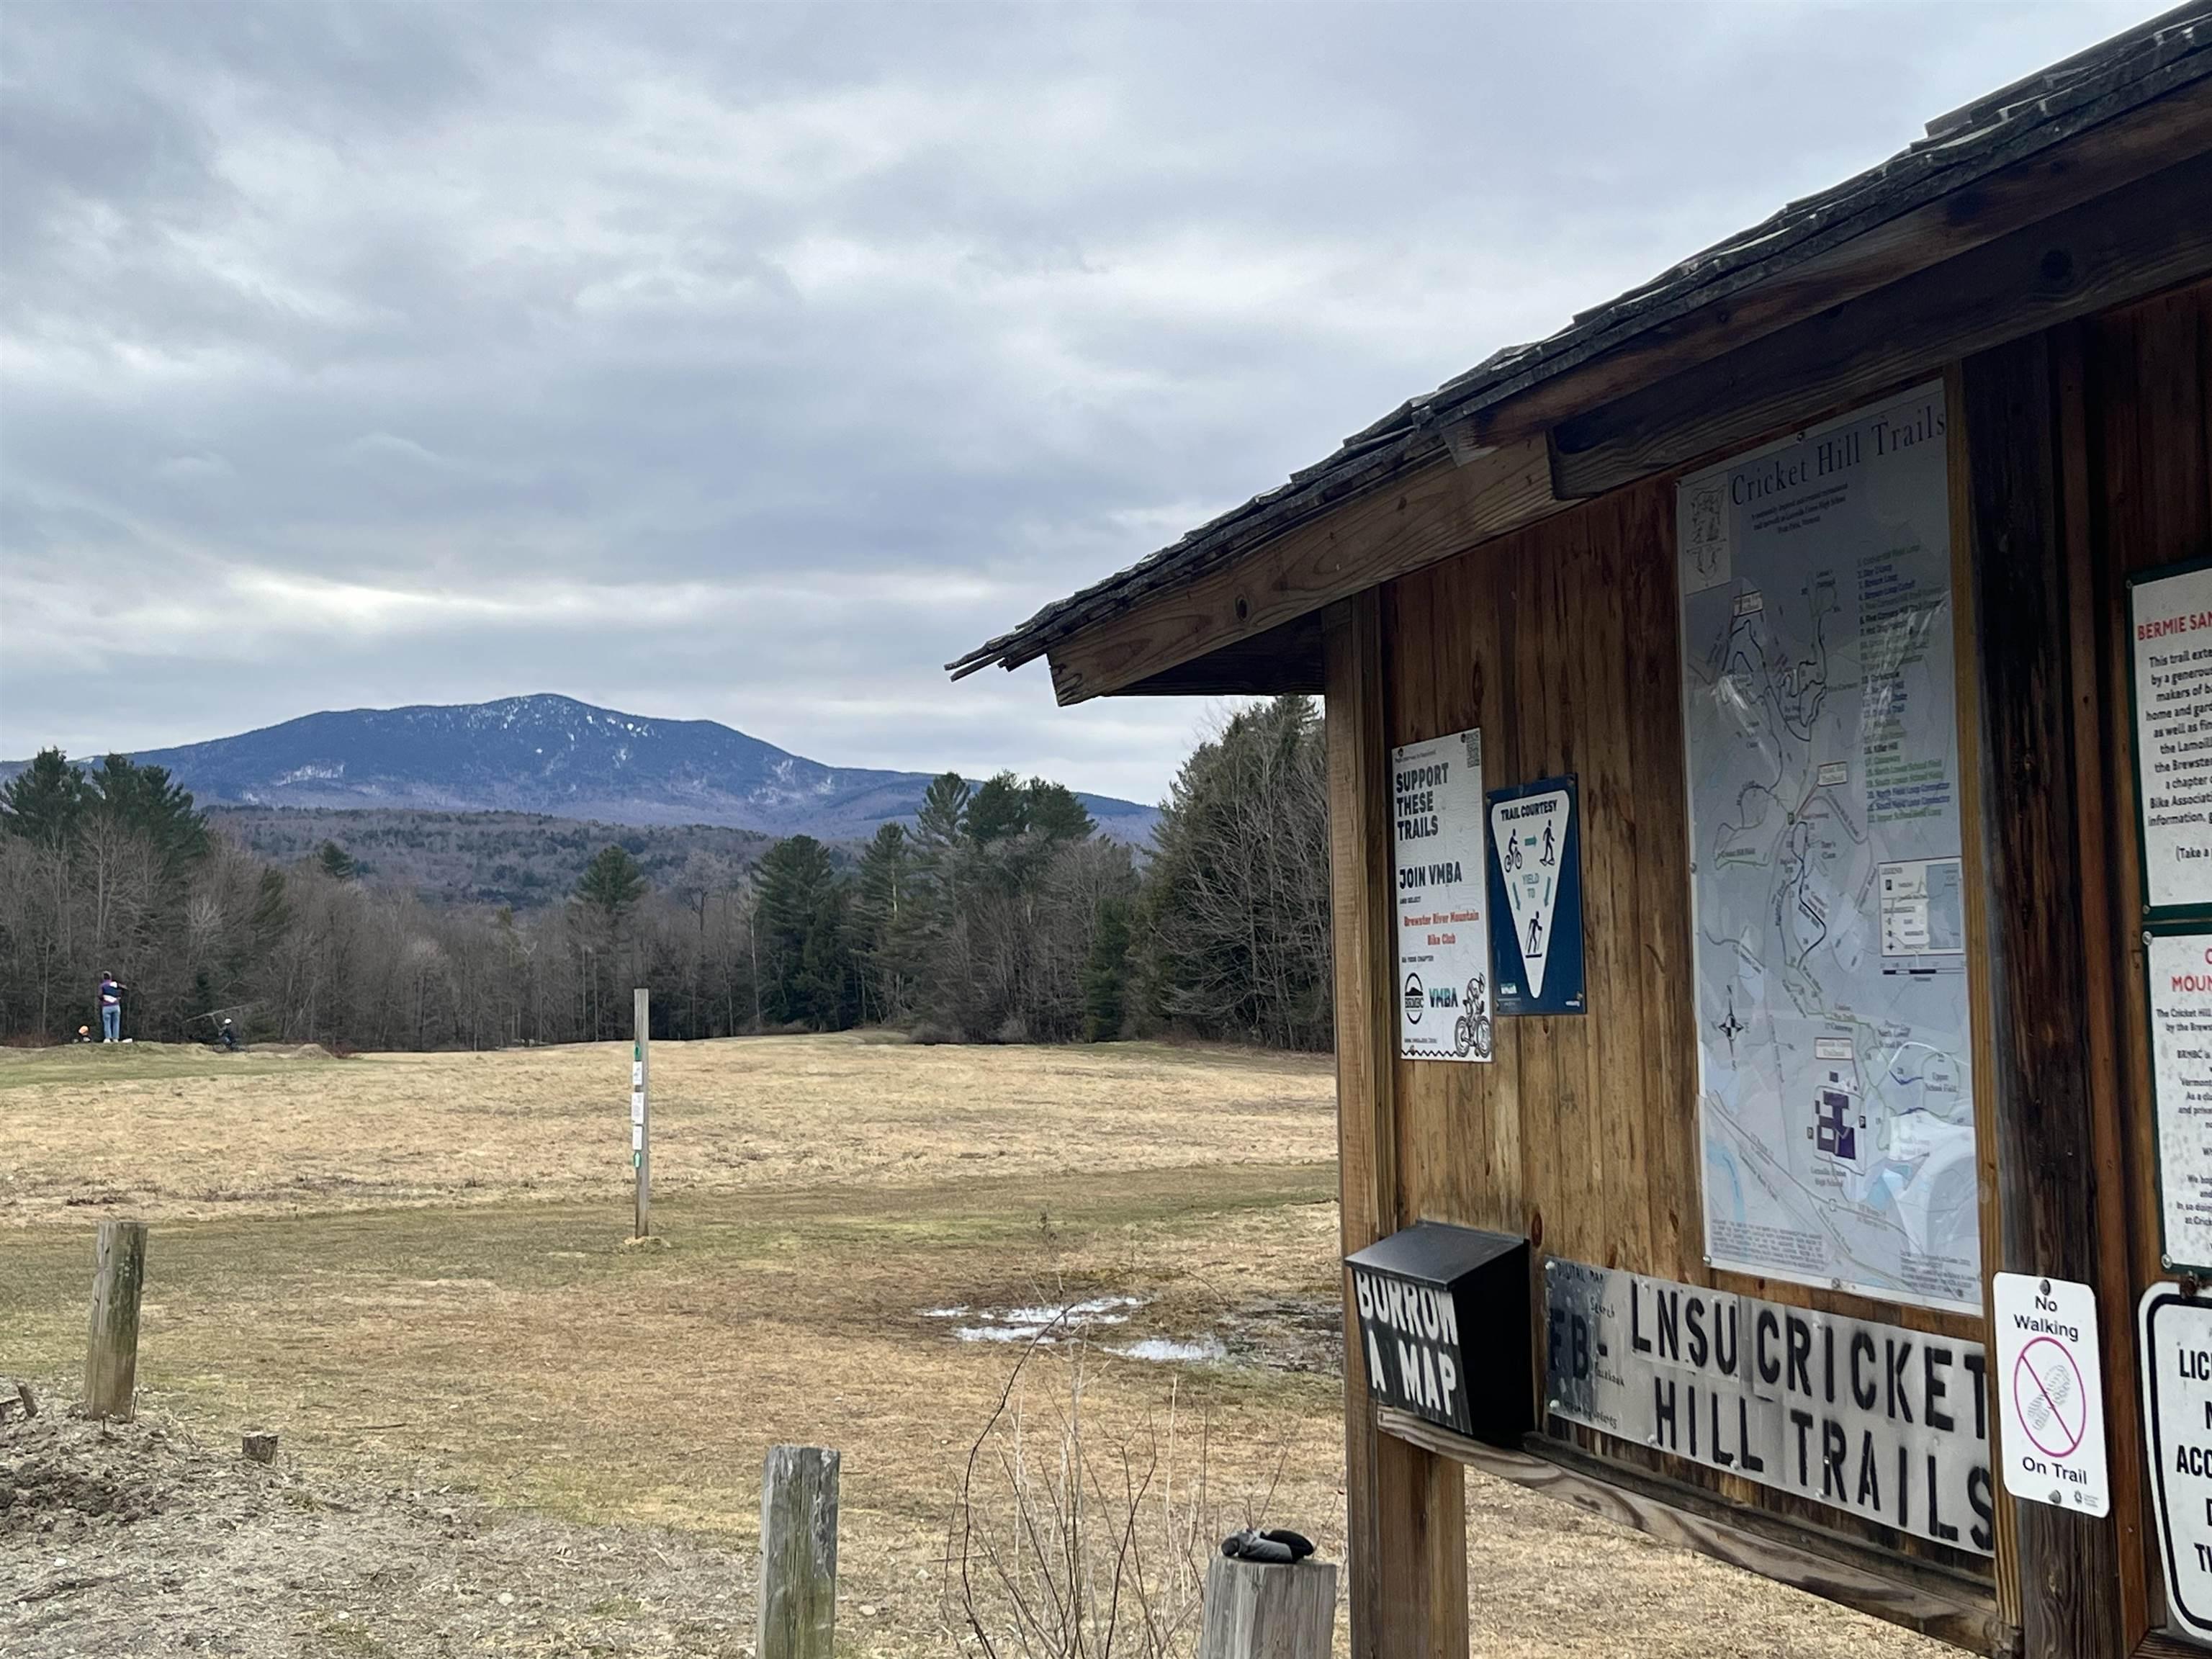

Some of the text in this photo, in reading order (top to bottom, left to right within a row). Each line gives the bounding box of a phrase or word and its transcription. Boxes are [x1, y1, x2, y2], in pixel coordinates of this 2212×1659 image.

[1732, 461, 1807, 505] Cricket
[1817, 432, 1861, 477] Hill
[1871, 405, 1944, 457] Trails
[2138, 616, 2186, 641] BERMIE
[2149, 655, 2167, 668] This
[2170, 649, 2190, 663] trail
[2151, 674, 2162, 688] by
[2157, 689, 2190, 702] makers
[2193, 683, 2201, 696] of
[2146, 711, 2172, 721] home
[2175, 703, 2191, 717] and
[2154, 729, 2163, 738] as
[2165, 723, 2185, 735] well
[2188, 724, 2198, 732] as
[2160, 743, 2175, 755] the
[1396, 762, 1449, 793] SUPPORT
[2154, 762, 2170, 773] the
[2172, 777, 2208, 790] chapter
[1397, 791, 1434, 818] THESE
[1501, 799, 1557, 821] TRAIL COURTESY
[1398, 815, 1439, 841] TRAILS
[2176, 845, 2209, 862] (Take a
[1399, 861, 1462, 889] JOIN VMBA
[1521, 872, 1539, 886] YIELD
[1527, 887, 1536, 899] TO
[1404, 914, 1431, 927] Brewster
[1450, 909, 1479, 923] Mountain
[1429, 987, 1459, 1008] VMBA
[1356, 1271, 1459, 1346] BORROW
[2035, 1295, 2057, 1312] No
[2013, 1314, 2079, 1342] Walking
[1632, 1279, 1737, 1376] LNSU
[1757, 1310, 1986, 1440] CRICKET
[2179, 1349, 2212, 1381] LIC
[1368, 1329, 1457, 1416] A MAP
[1655, 1376, 1994, 1551] HILL TRAILS
[2023, 1457, 2087, 1485] On Trail
